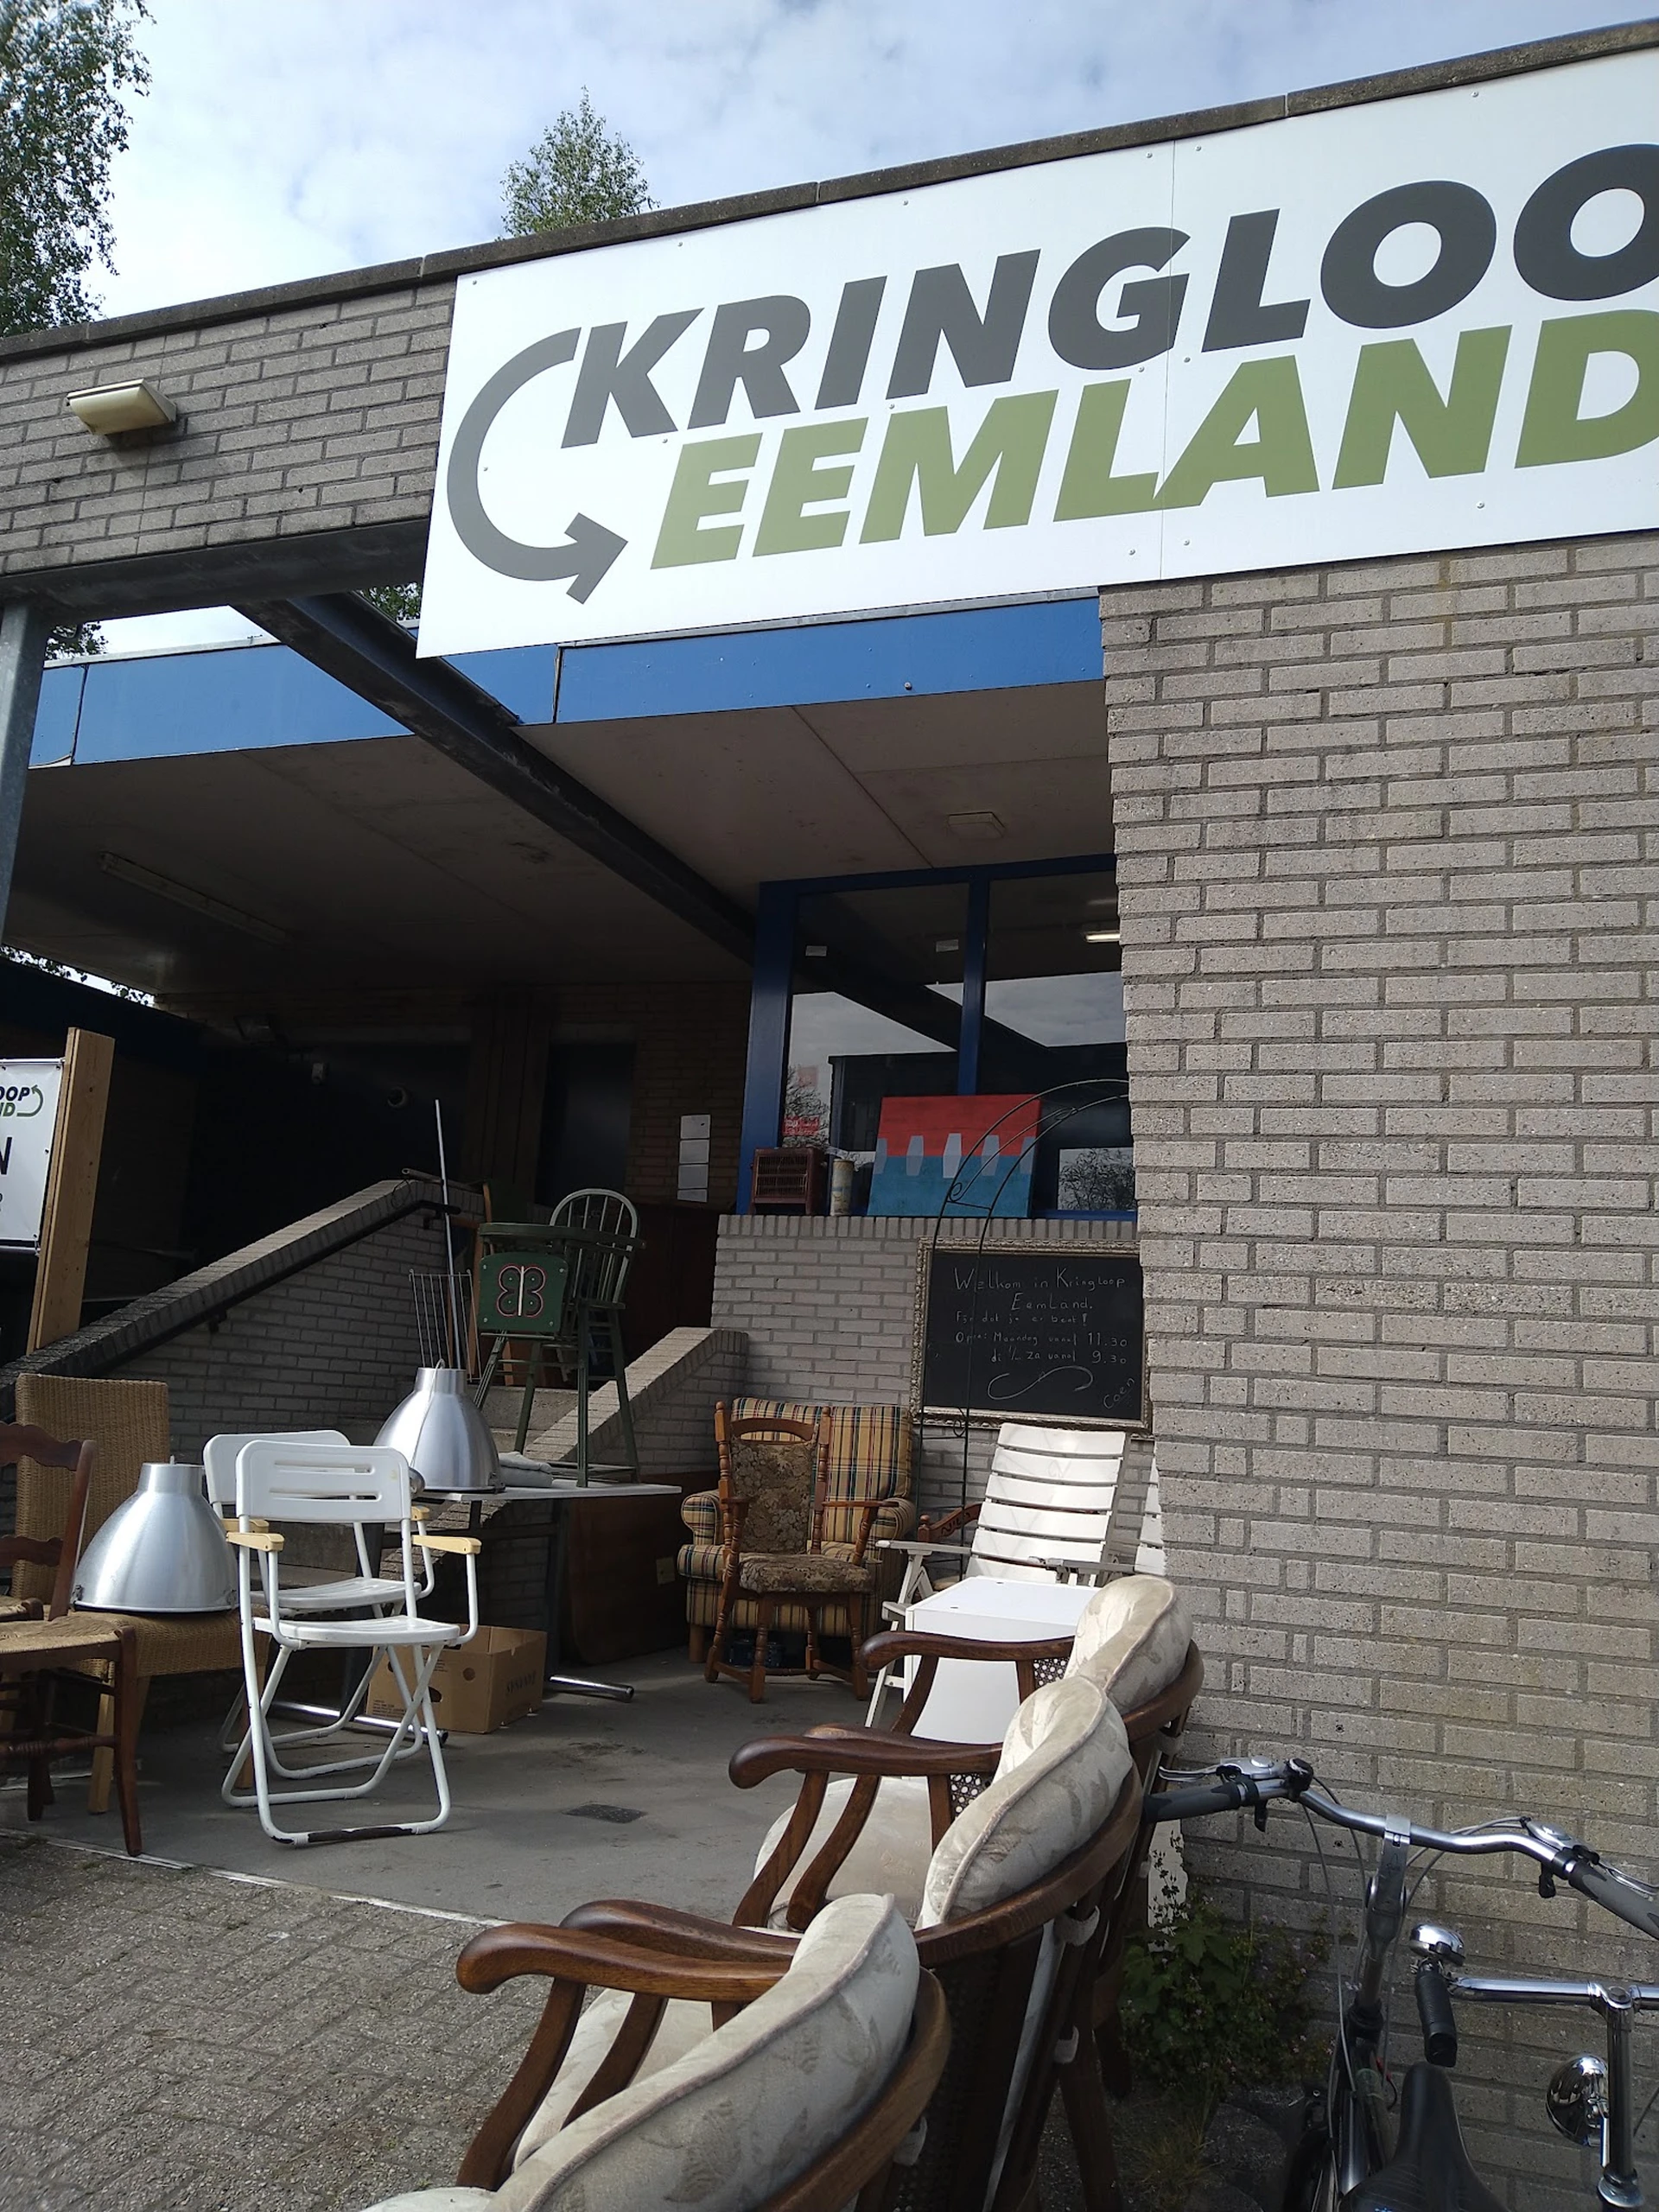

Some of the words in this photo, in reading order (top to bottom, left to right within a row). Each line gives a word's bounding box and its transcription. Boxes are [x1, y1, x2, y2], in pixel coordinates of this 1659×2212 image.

[649, 309, 1659, 570] EEMLAND
[954, 1268, 1021, 1290] Welkom
[1034, 1278, 1049, 1288] in
[1091, 1350, 1128, 1364] 9.30
